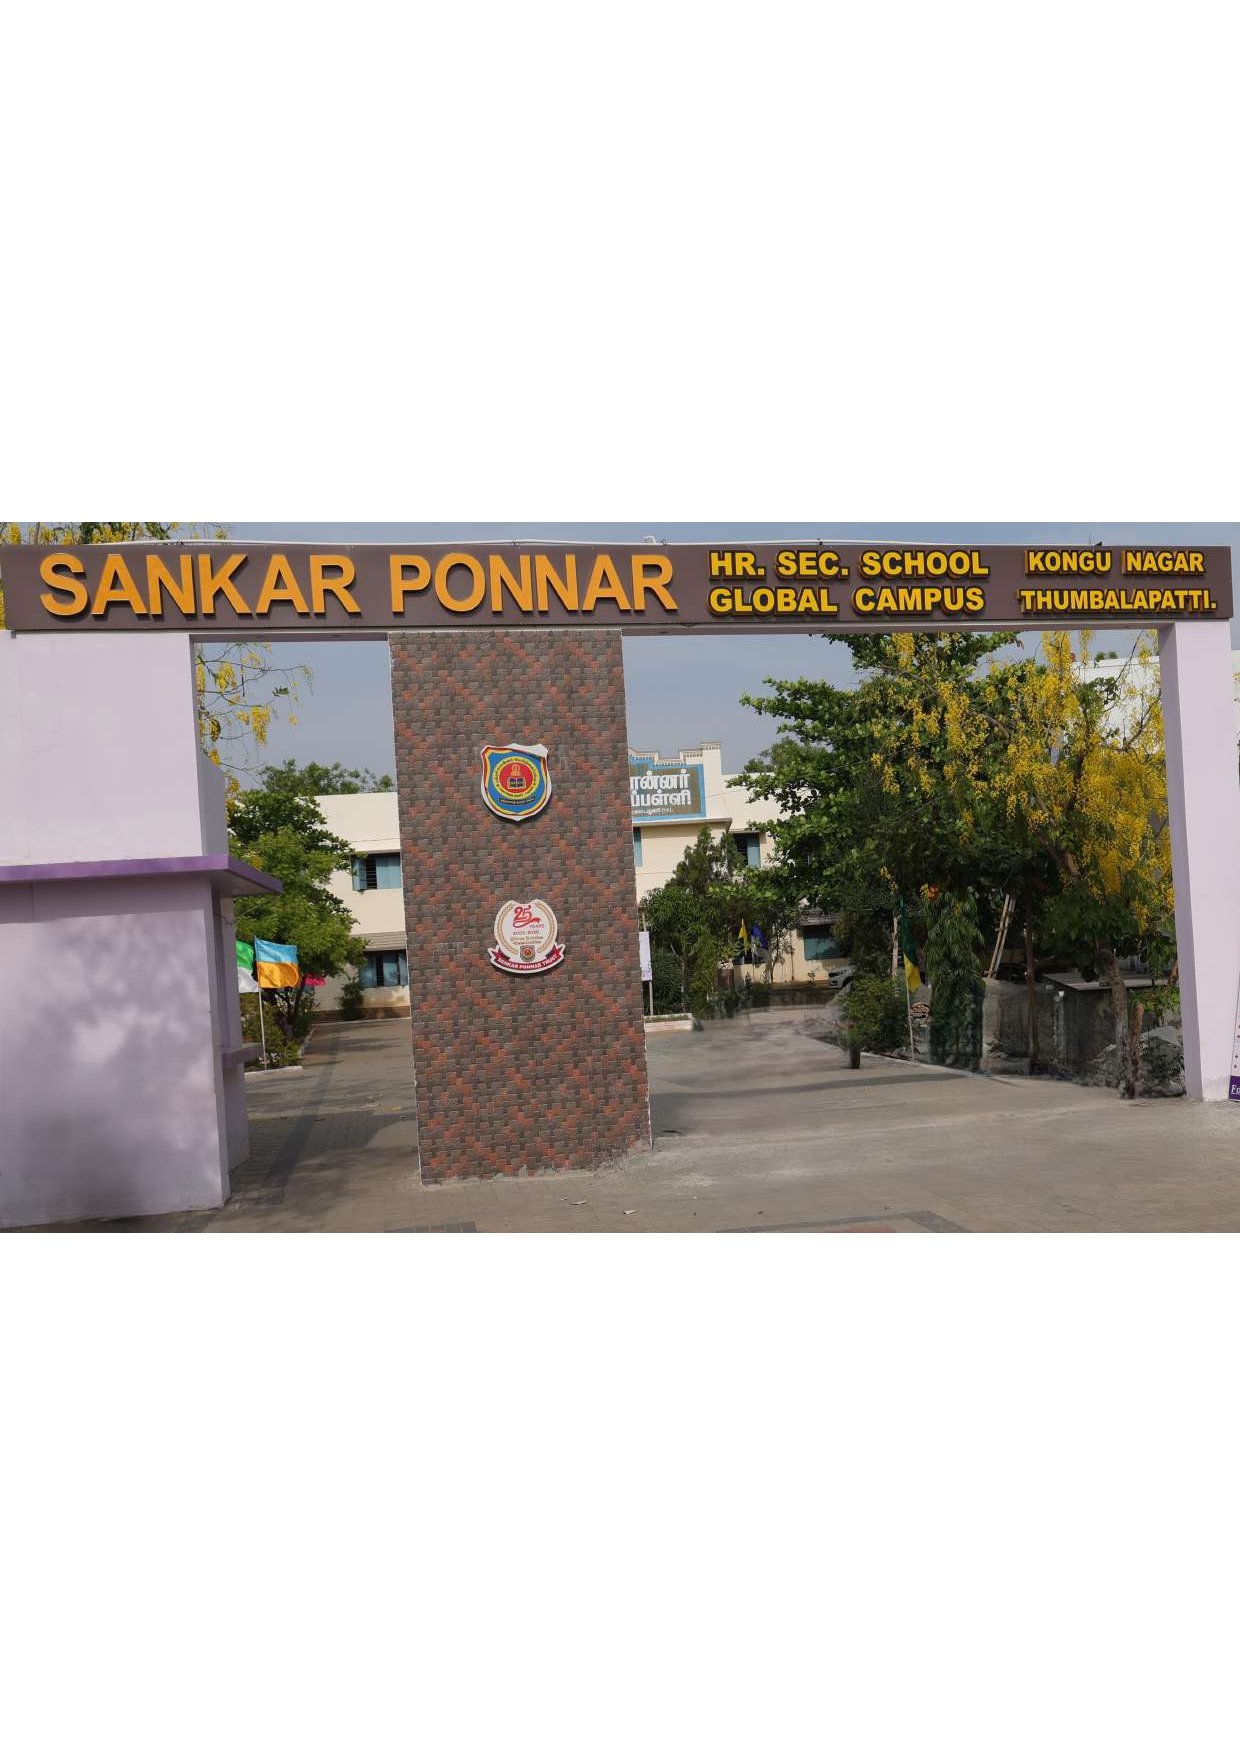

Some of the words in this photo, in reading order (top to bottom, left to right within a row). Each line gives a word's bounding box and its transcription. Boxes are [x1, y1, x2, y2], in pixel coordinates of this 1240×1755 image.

[710, 551, 765, 577] HR.
[777, 551, 850, 577] SEC.
[862, 550, 989, 576] SCHOOL
[1027, 550, 1112, 573] KONGU
[1123, 550, 1205, 573] NAGAR
[40, 553, 360, 616] SANKAR
[390, 553, 679, 613] PONNAR
[709, 587, 838, 614] GLOBAL
[855, 586, 985, 612] CAMPUS
[1019, 588, 1217, 610] THUMBALAPATTI.
[513, 905, 536, 925] 25
